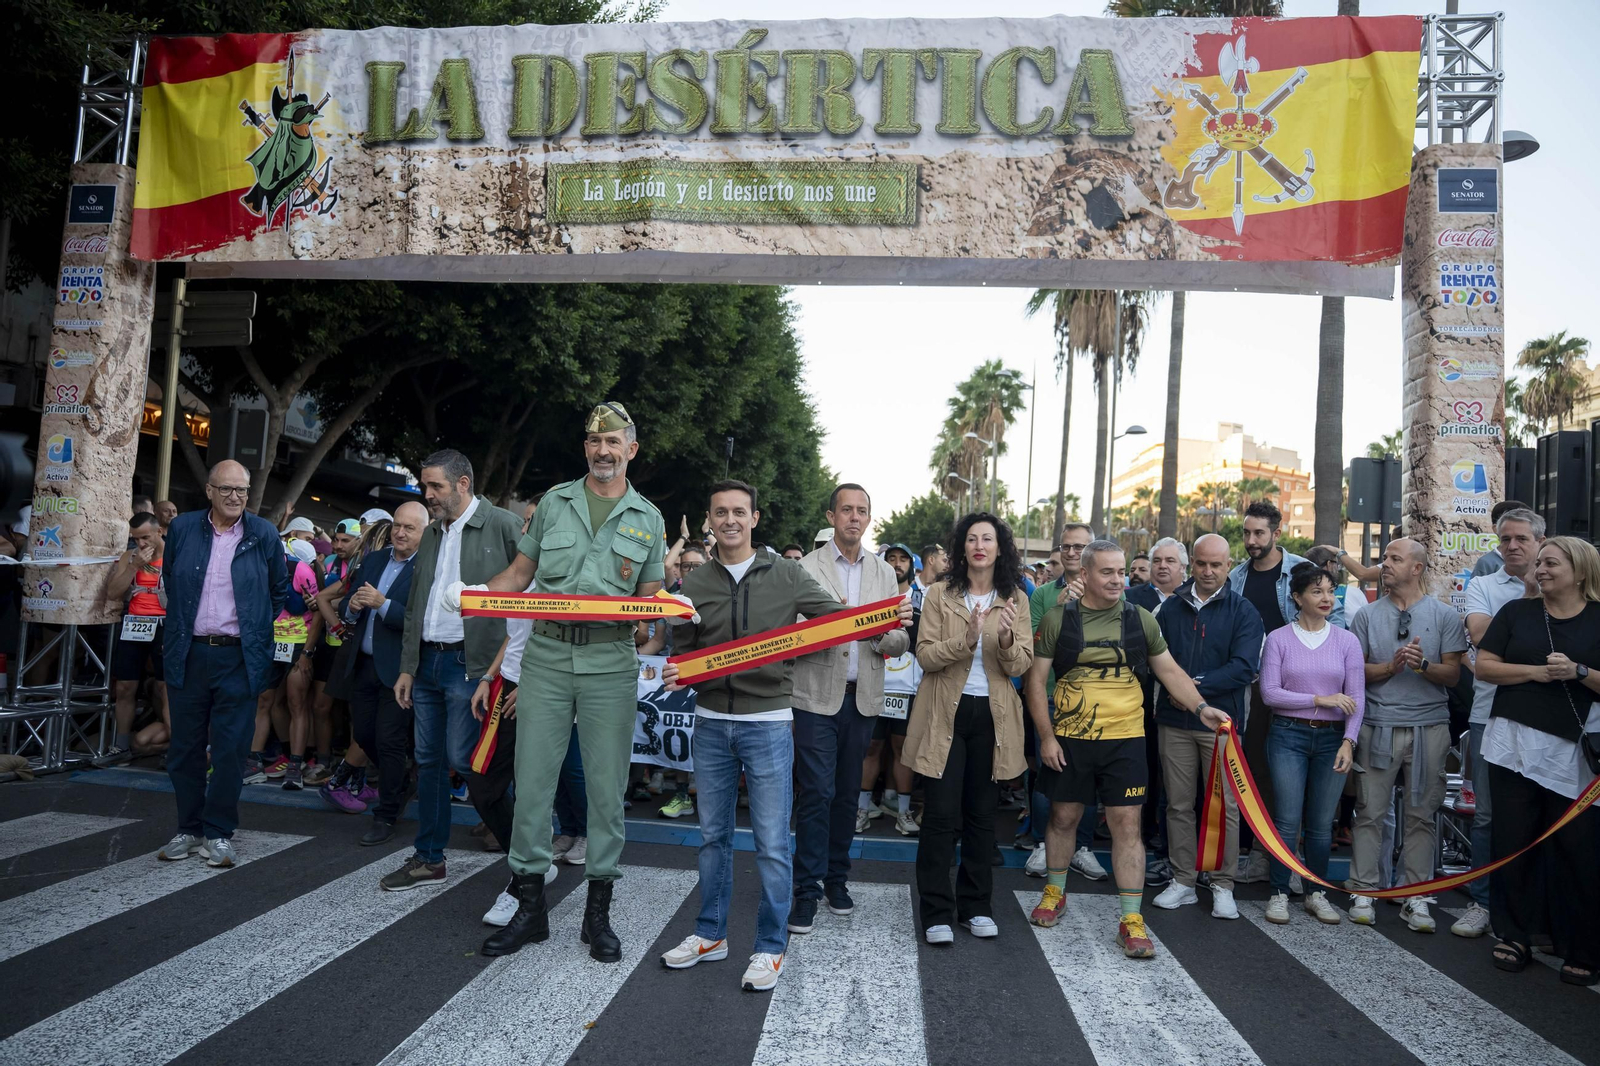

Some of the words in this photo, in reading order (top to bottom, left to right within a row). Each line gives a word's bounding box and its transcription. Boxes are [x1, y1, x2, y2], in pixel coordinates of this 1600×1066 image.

[364, 58, 484, 143] LA
[508, 28, 1136, 138] DESÉRTICA
[583, 179, 604, 200] La
[614, 176, 666, 204] Legión
[676, 184, 688, 204] y
[698, 178, 713, 200] el
[722, 178, 794, 202] desierto
[804, 185, 834, 202] nos
[844, 184, 877, 202] une
[1438, 228, 1498, 248] Coca-Cola
[64, 237, 109, 252] Coca-Cola
[61, 276, 103, 288] RENTA
[1441, 275, 1496, 287] RENTA
[60, 289, 102, 304] TODO
[1441, 289, 1497, 307] TODO
[45, 404, 89, 415] primaflor
[1440, 424, 1500, 436] primaflor
[45, 466, 72, 474] Almería
[1453, 496, 1488, 506] Almería
[1455, 506, 1486, 514] Activa
[619, 605, 663, 613] ALMERÍA
[854, 609, 898, 628] ALMERÍA
[131, 624, 153, 632] 2224
[760, 636, 793, 650] DESÉRTICA
[751, 649, 773, 658] DESIERTO
[885, 698, 903, 709] 600
[1229, 758, 1246, 794] ALMERÍA
